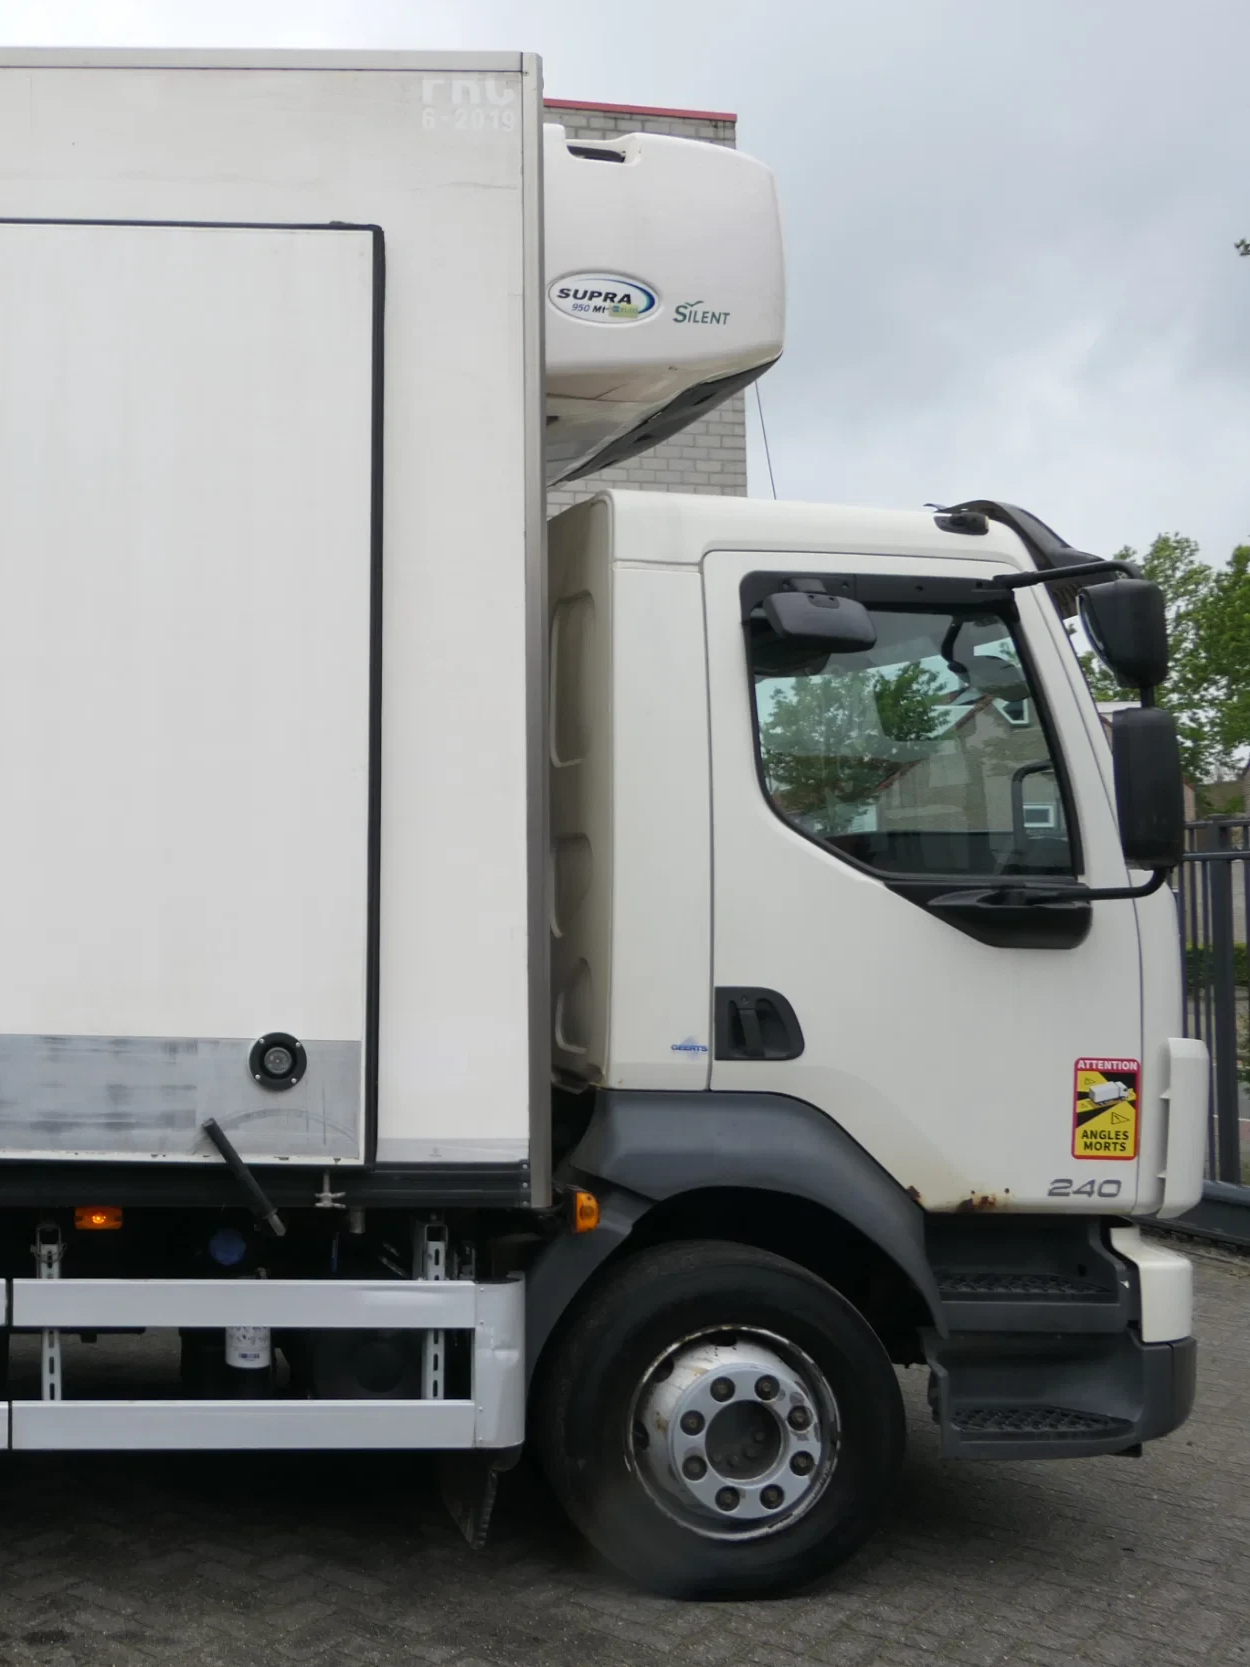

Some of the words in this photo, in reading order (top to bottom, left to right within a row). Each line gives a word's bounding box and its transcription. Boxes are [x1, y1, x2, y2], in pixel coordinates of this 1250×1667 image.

[557, 288, 632, 304] SUPRA
[571, 303, 590, 313] 950
[672, 303, 731, 325] SILENT
[1077, 1060, 1138, 1071] ATTENTION
[1081, 1129, 1129, 1141] ANGLES
[1083, 1141, 1127, 1152] MORTS
[1047, 1178, 1122, 1198] 240
